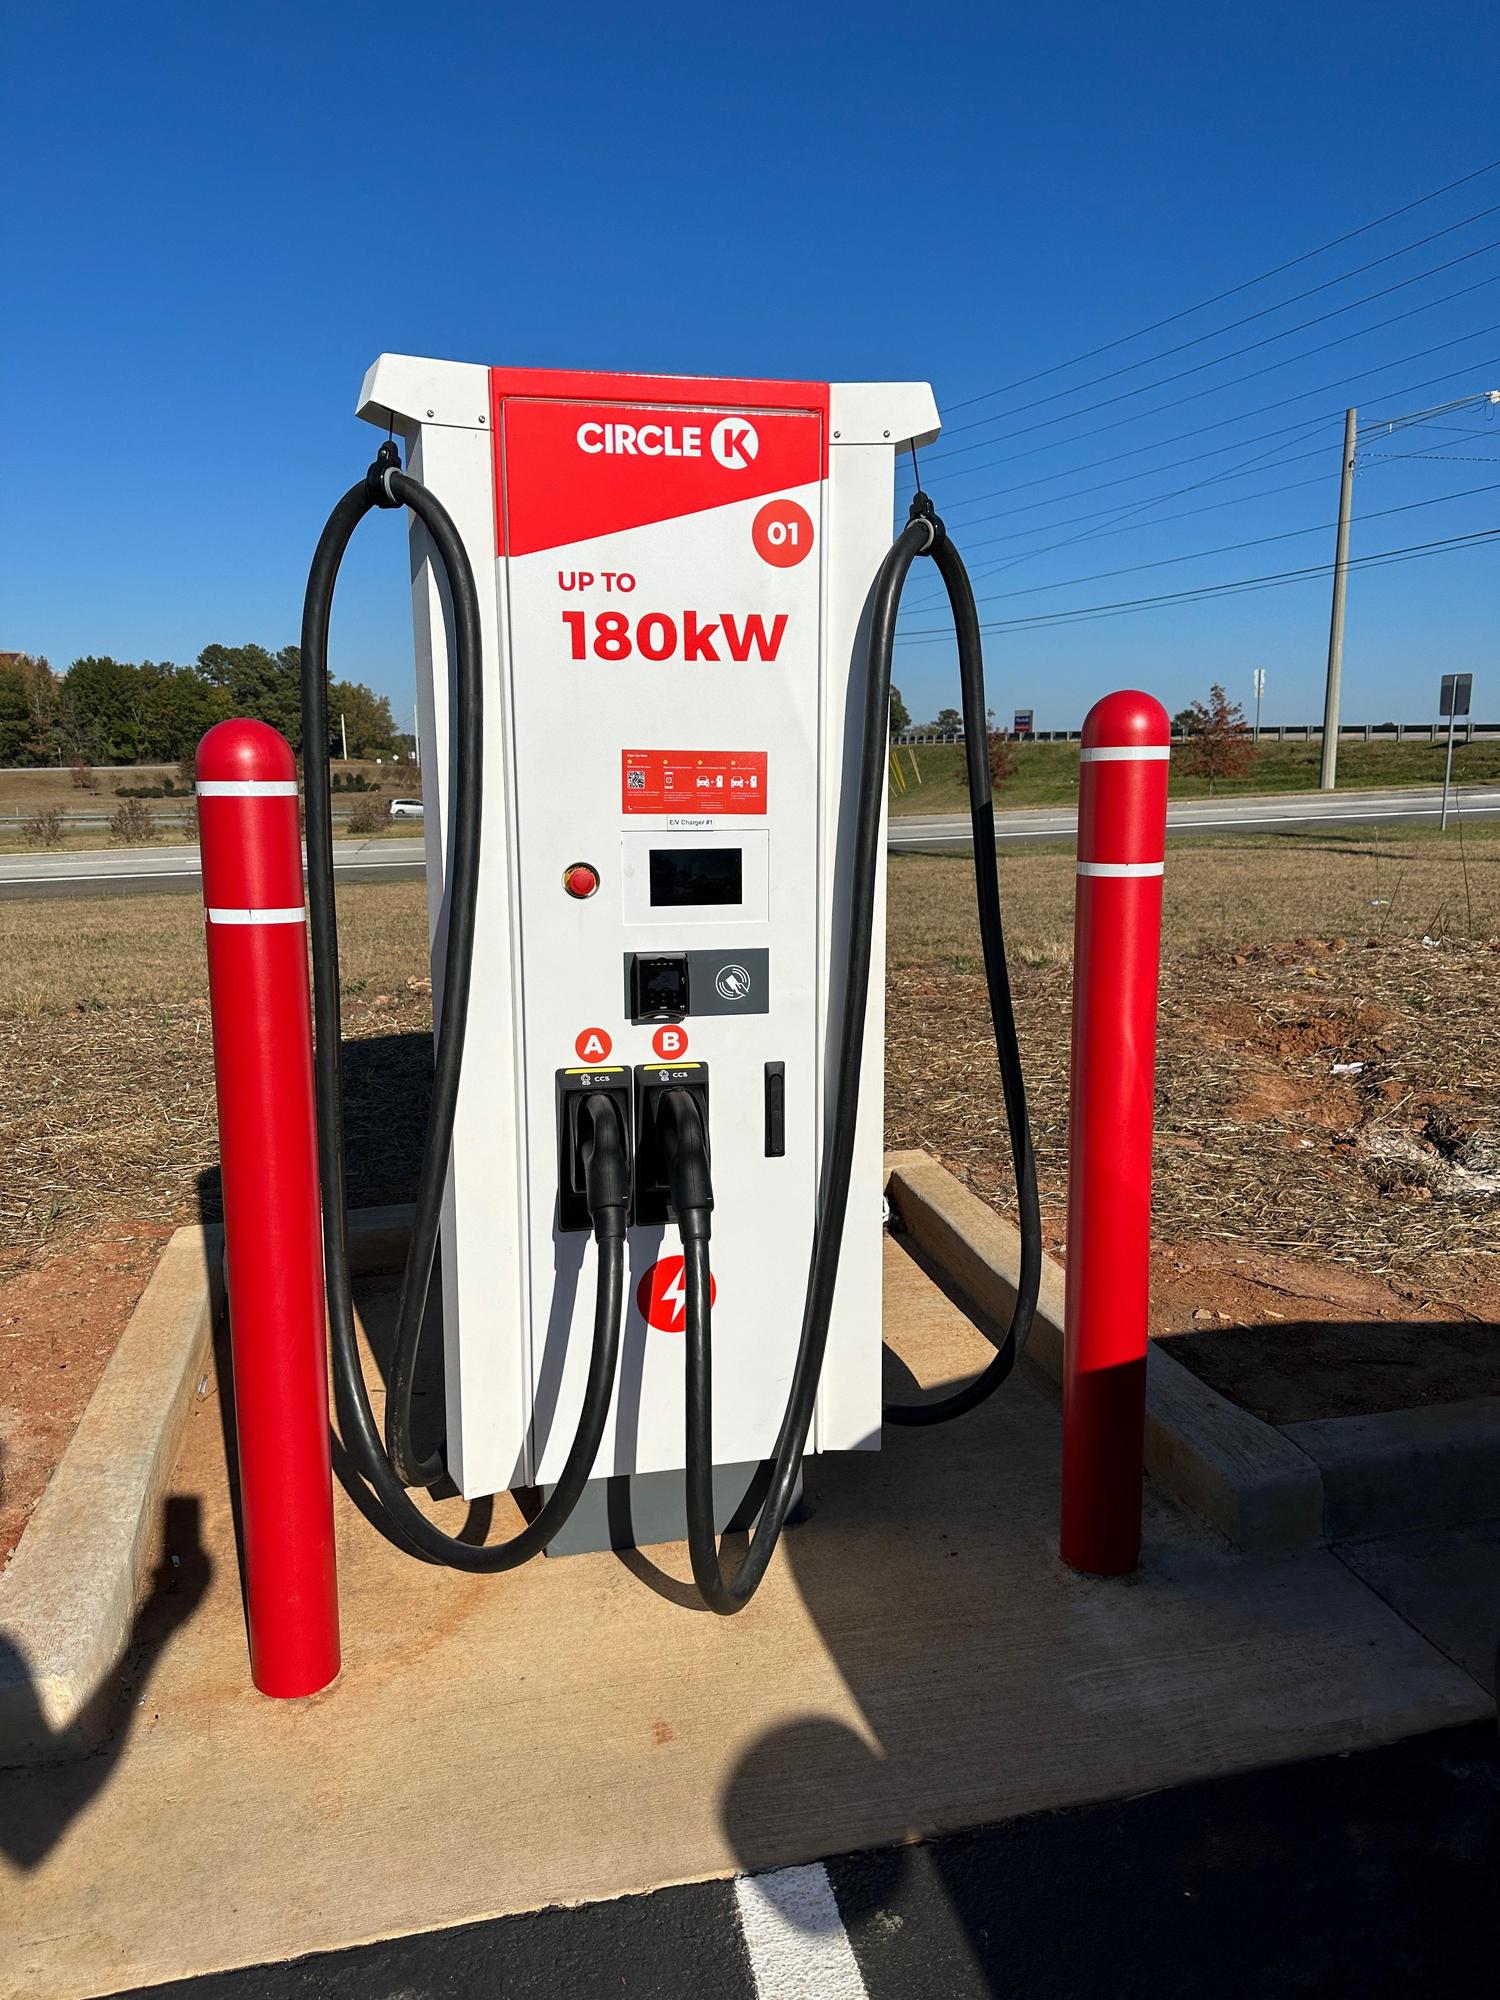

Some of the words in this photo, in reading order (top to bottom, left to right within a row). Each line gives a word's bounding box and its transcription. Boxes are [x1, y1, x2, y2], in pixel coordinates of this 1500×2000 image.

[576, 422, 702, 457] CIRCLE
[722, 427, 757, 468] K
[766, 521, 799, 546] 01
[558, 571, 595, 592] UP
[600, 572, 637, 593] TO
[561, 610, 790, 662] 180kW
[681, 819, 705, 827] Charger
[583, 1034, 605, 1055] A
[662, 1031, 681, 1051] B
